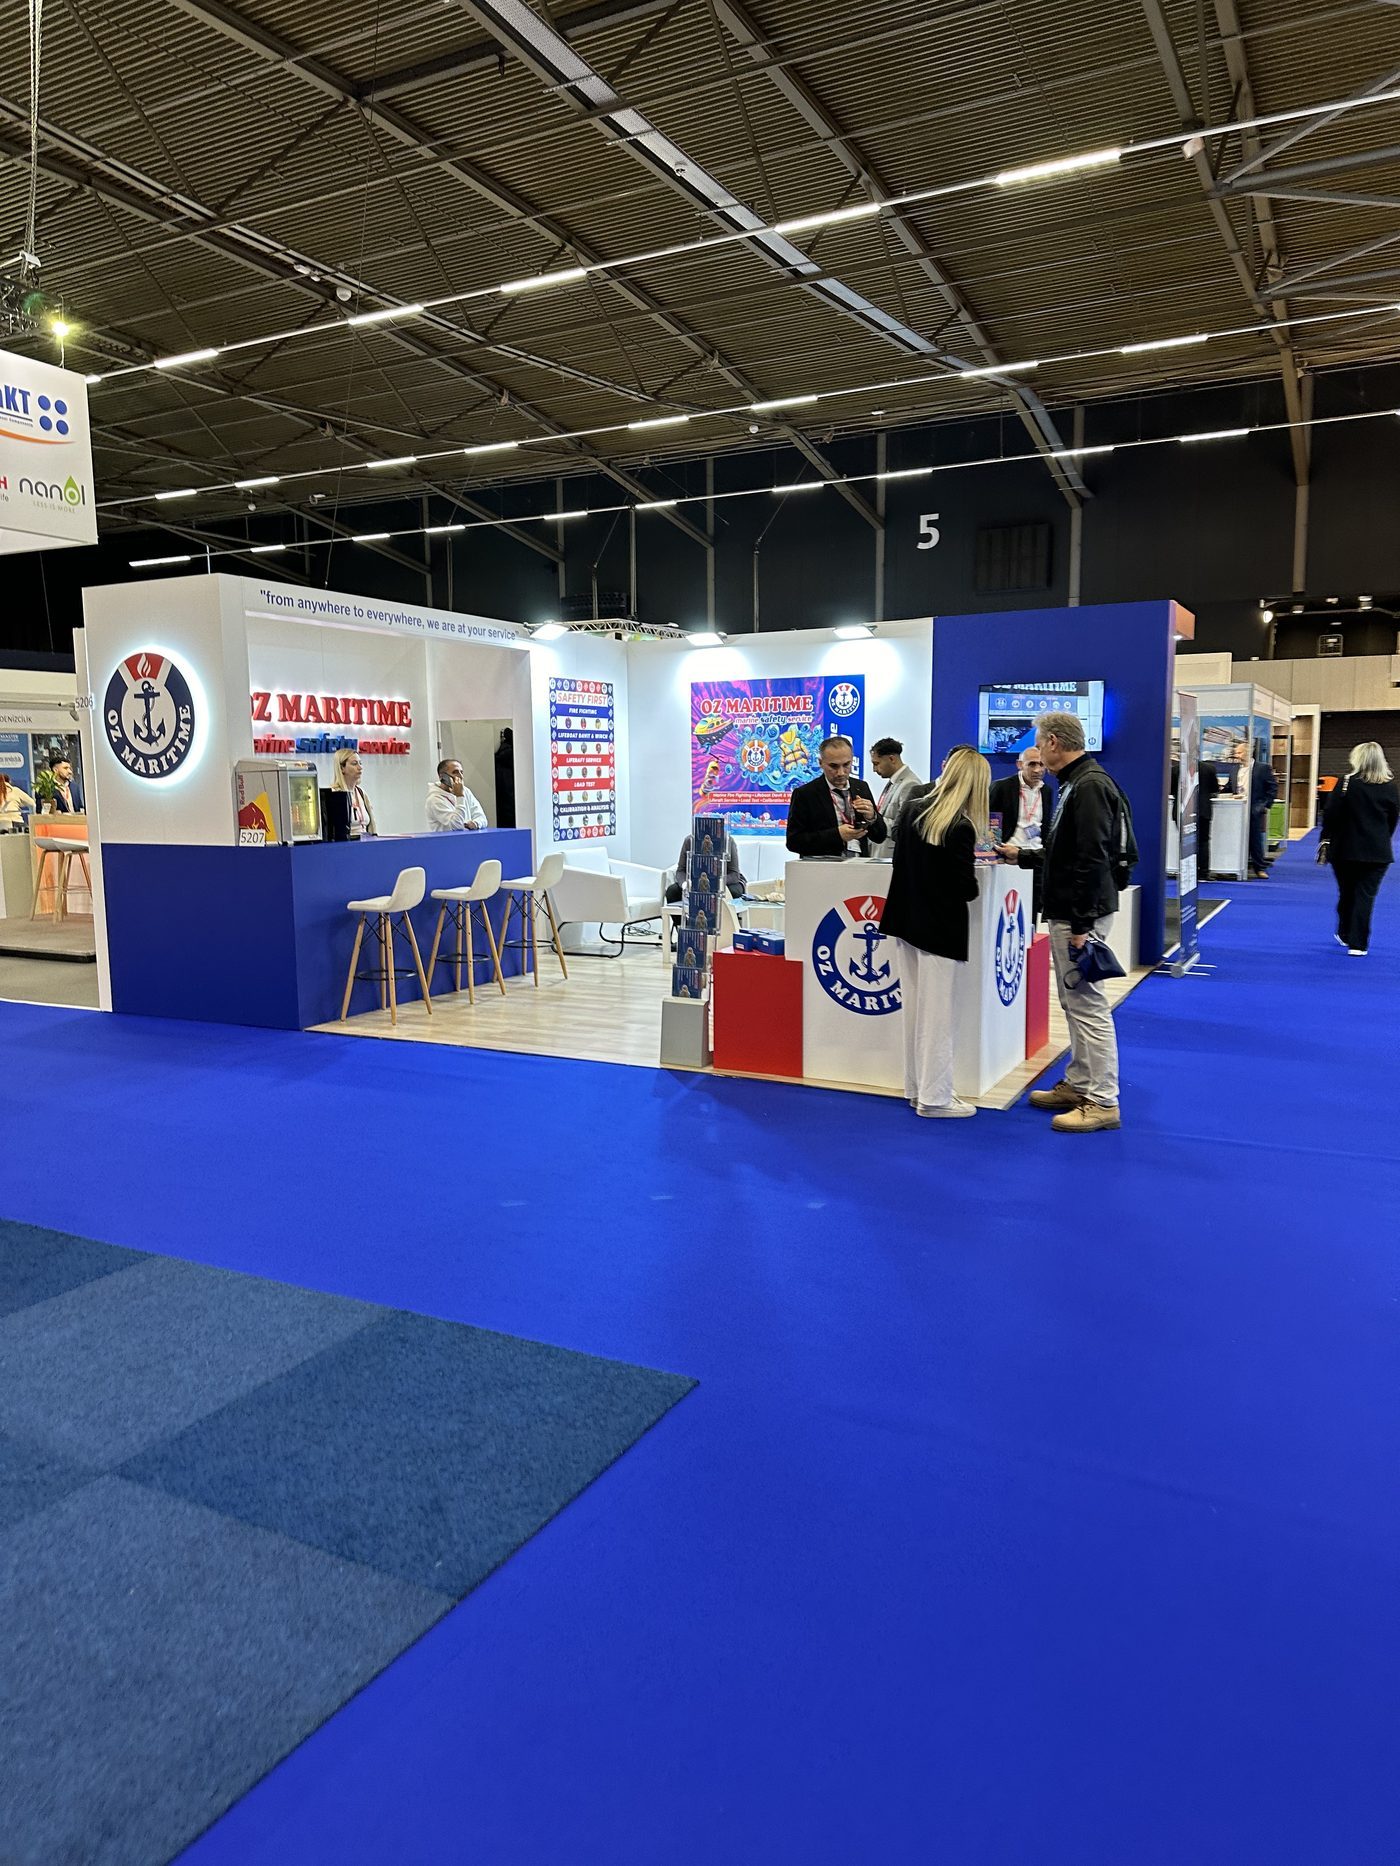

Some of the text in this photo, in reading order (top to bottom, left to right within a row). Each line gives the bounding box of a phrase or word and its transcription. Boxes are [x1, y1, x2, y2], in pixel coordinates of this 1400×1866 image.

[917, 513, 940, 549] 5
[260, 589, 294, 607] "from
[298, 598, 351, 615] anywhere
[354, 605, 364, 618] to
[367, 609, 425, 629] everywhere,
[427, 618, 439, 630] we
[442, 621, 456, 632] are
[458, 623, 466, 633] at
[468, 626, 487, 637] your
[75, 696, 93, 709] 5206
[250, 692, 412, 727] Z MARITIME
[557, 692, 607, 706] SAFETY FIRST
[701, 696, 813, 714] OZ MARITIME
[735, 716, 759, 724] marine
[760, 715, 786, 724] safety
[107, 704, 192, 774] OZ MARITIME
[296, 732, 358, 753] safety
[359, 737, 410, 754] service
[240, 832, 265, 843] 5207
[816, 945, 834, 976] OZ
